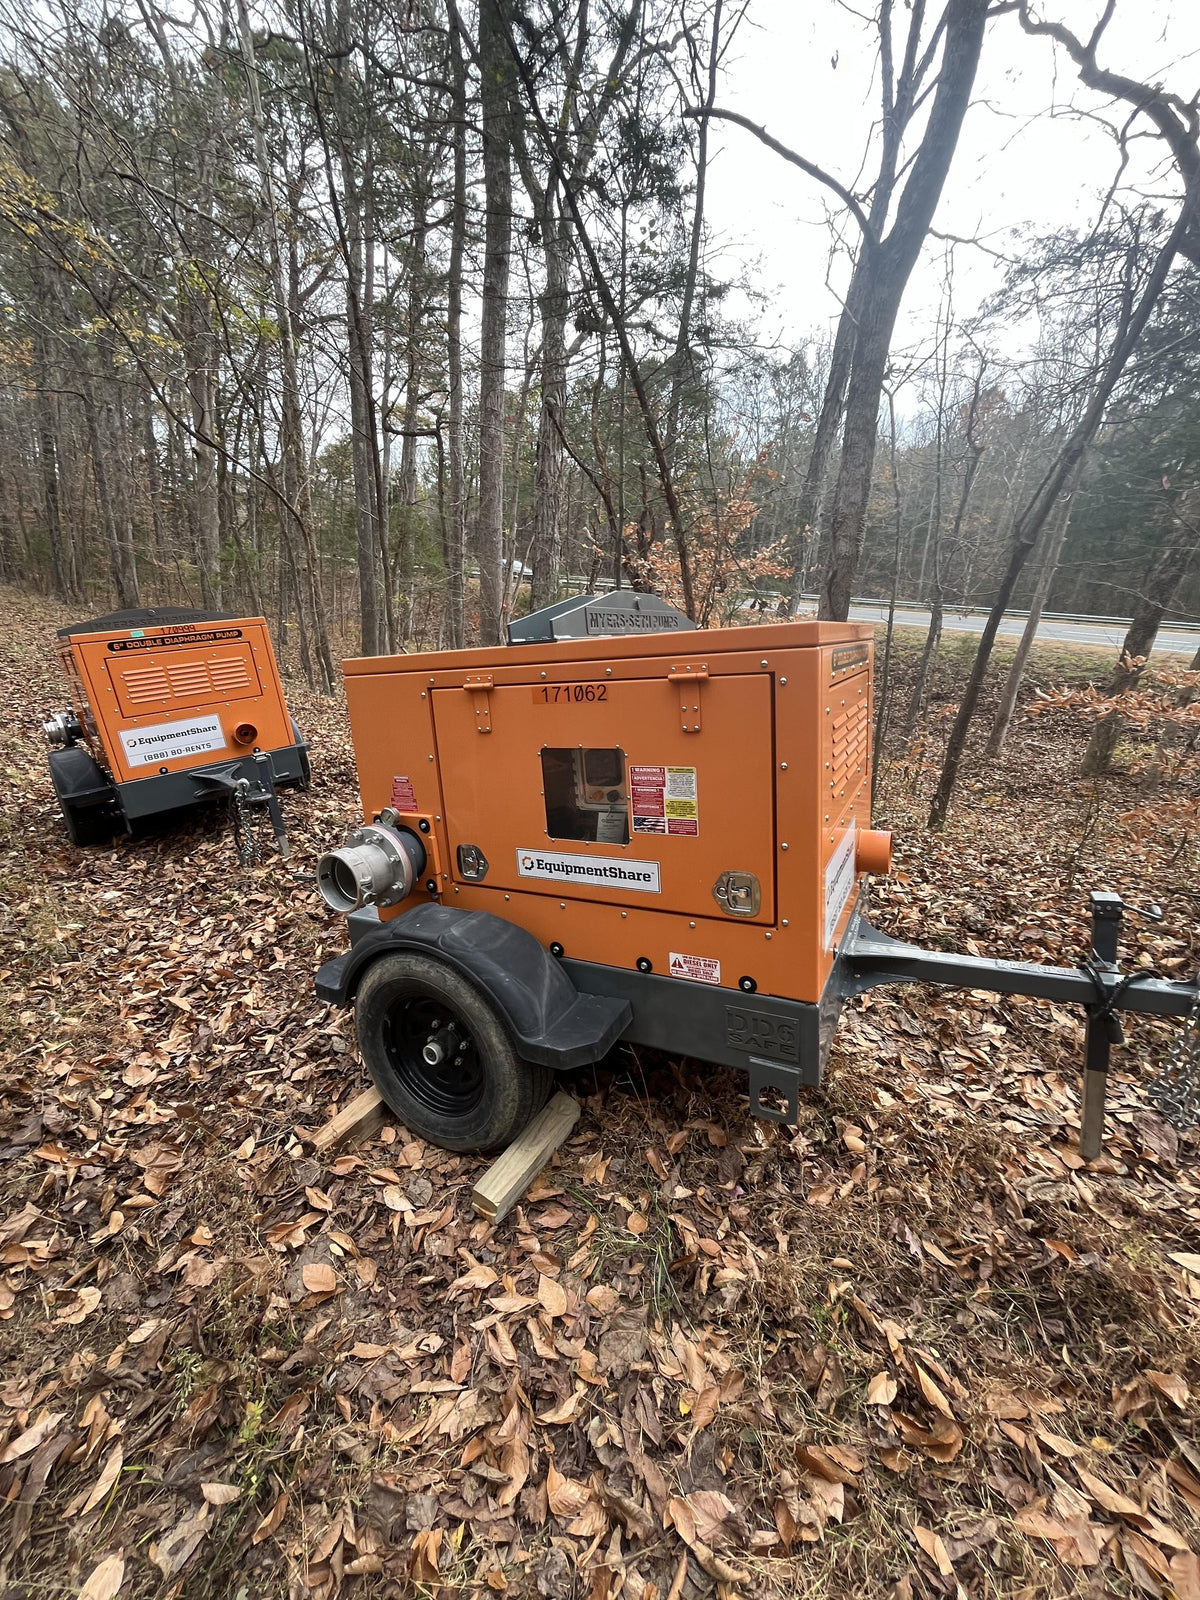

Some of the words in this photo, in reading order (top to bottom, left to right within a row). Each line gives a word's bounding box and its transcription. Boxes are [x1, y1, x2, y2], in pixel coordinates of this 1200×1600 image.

[653, 615, 679, 629] PUMPS
[126, 638, 163, 649] DOUBLE
[164, 633, 215, 645] DIAPHRAGM
[216, 631, 239, 640] PUMP
[541, 684, 608, 703] 171062
[138, 724, 218, 746] EquipmentShare
[143, 750, 169, 762] (888)
[170, 742, 212, 756] 80-RENTS
[535, 858, 652, 883] EquipmentShare
[683, 958, 702, 967] DIESEL
[703, 962, 718, 970] ONLY
[728, 1032, 797, 1056] SAFE
